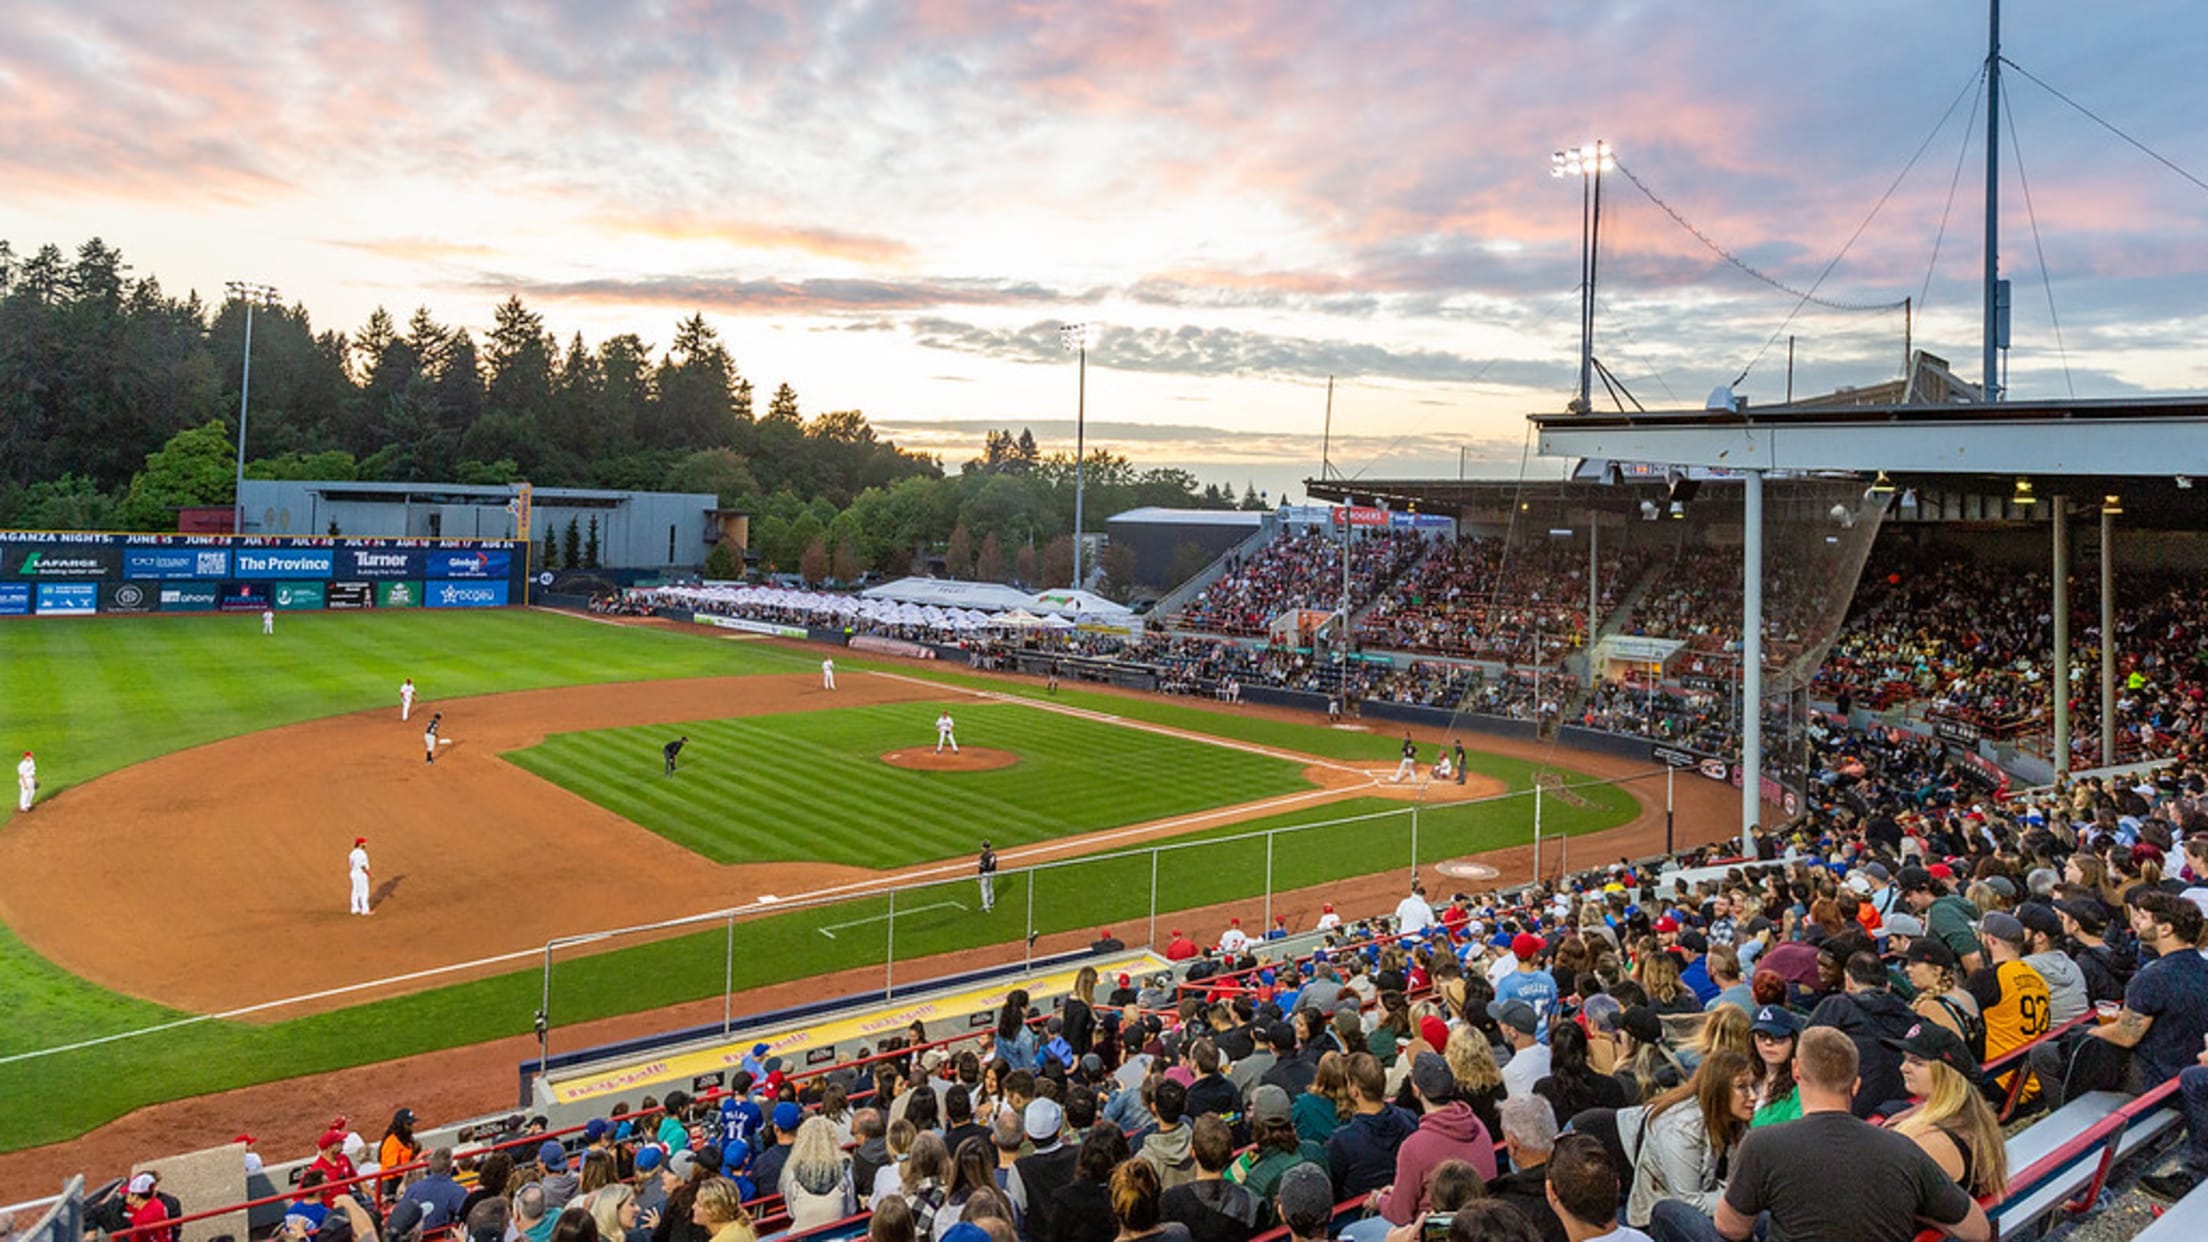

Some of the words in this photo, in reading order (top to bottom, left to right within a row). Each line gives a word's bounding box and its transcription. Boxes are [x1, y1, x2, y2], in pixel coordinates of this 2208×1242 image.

[239, 556, 267, 571] The
[268, 556, 330, 571] Province
[353, 551, 409, 567] Turner
[448, 557, 480, 568] Global
